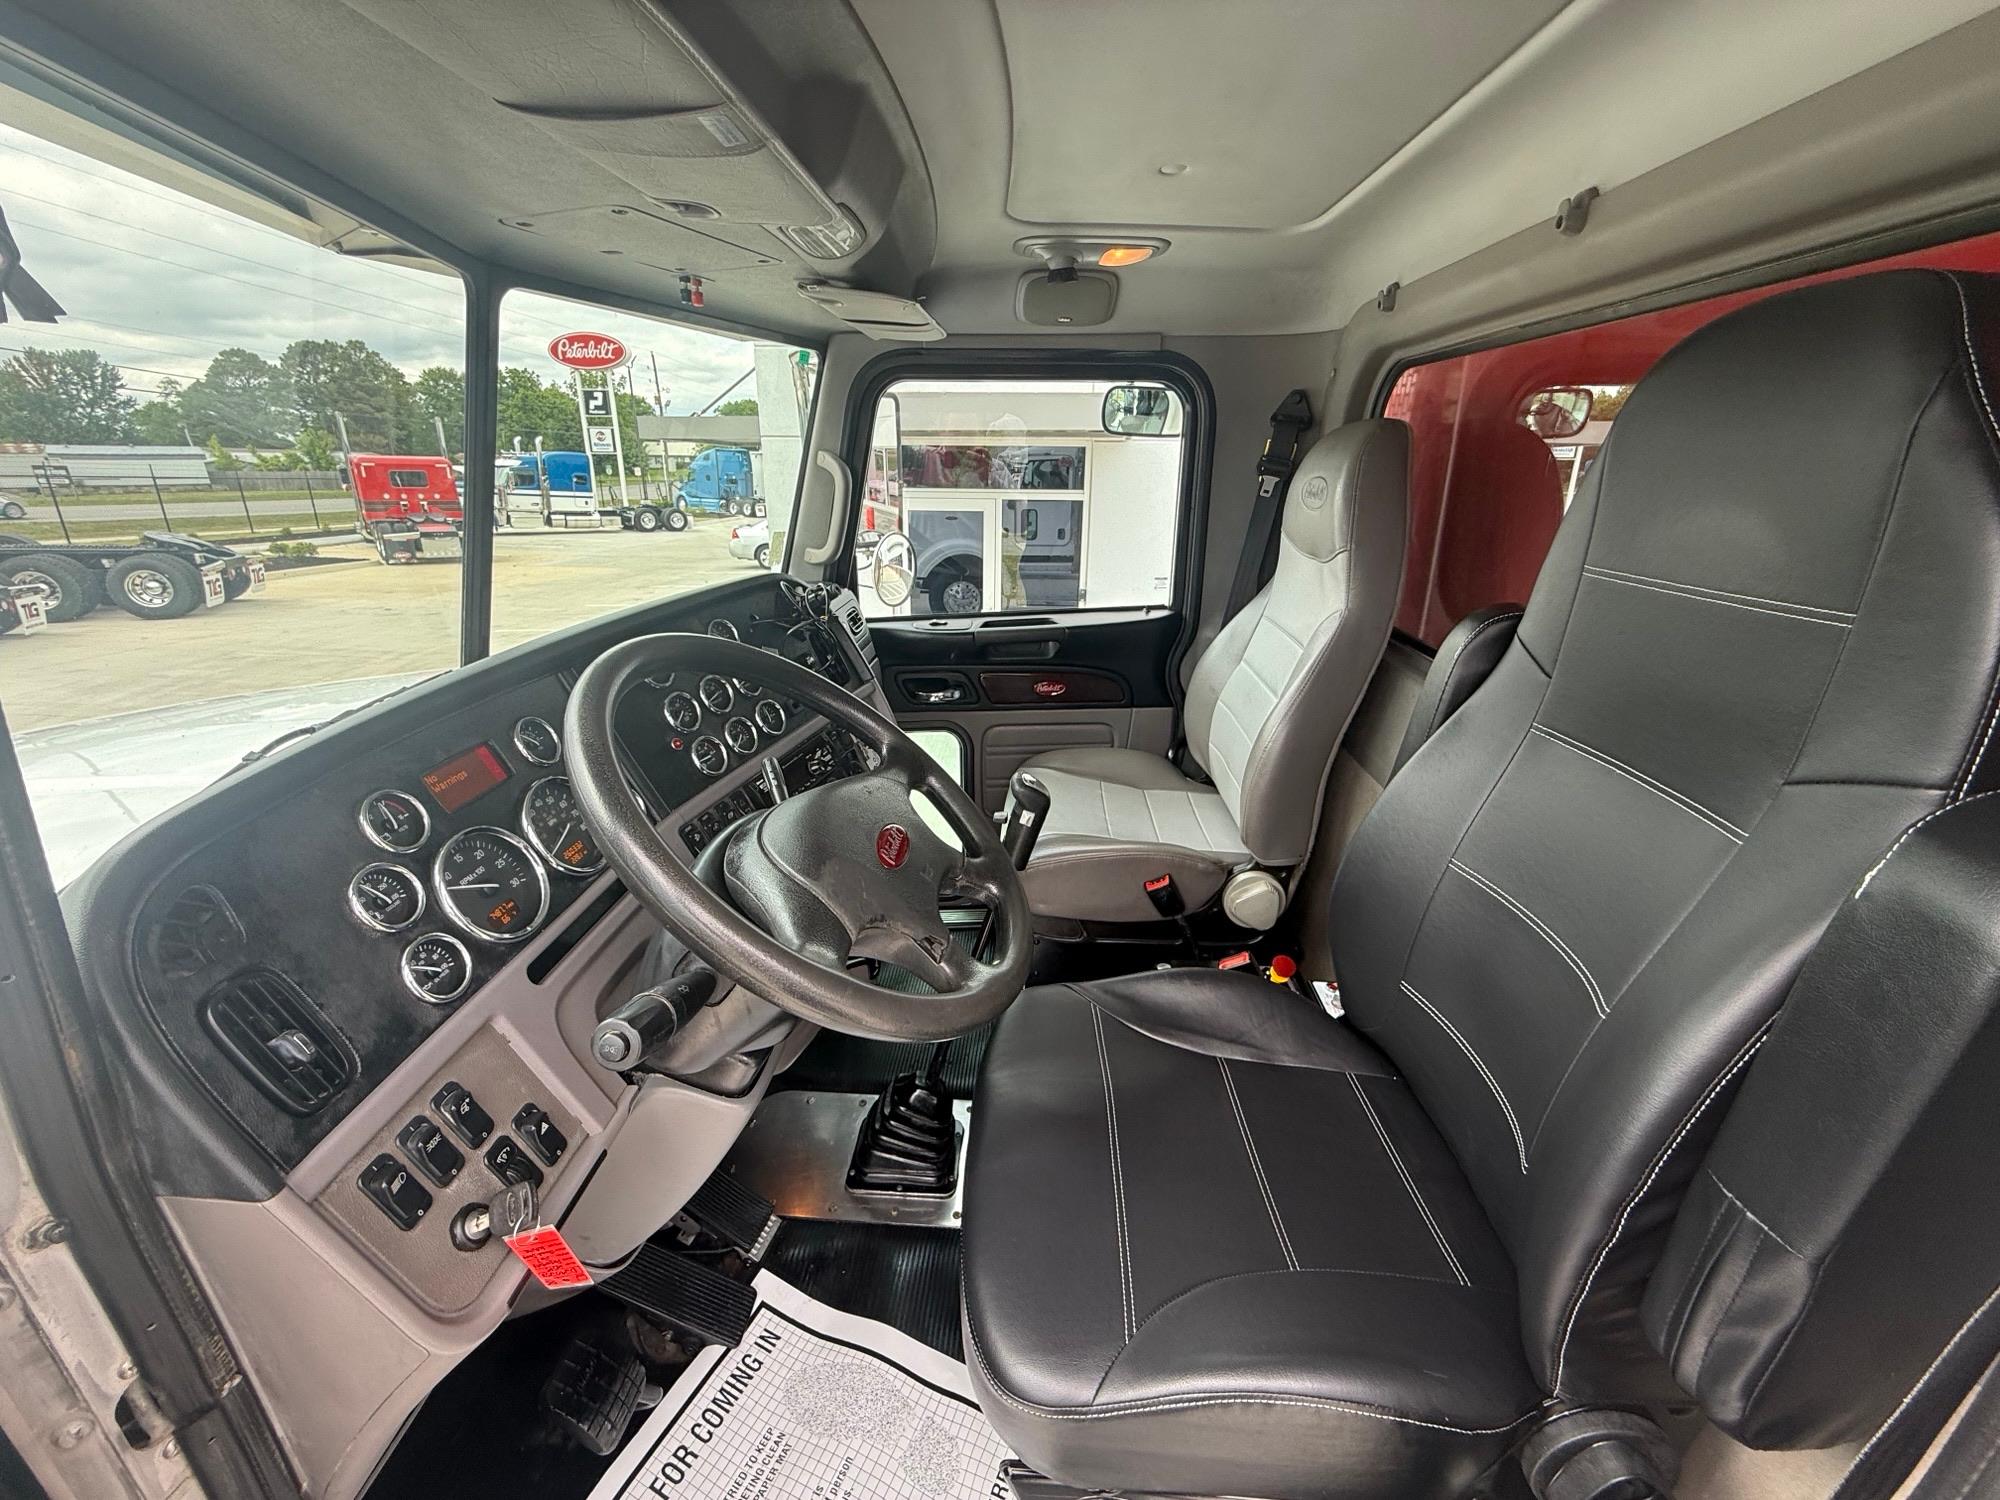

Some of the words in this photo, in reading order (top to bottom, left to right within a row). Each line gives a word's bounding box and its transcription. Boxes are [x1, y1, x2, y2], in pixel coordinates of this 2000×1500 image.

[557, 338, 619, 360] Peterbilt
[423, 775, 438, 785] No
[430, 770, 468, 793] Warnings
[453, 853, 464, 864] 15
[473, 849, 485, 860] 20
[494, 858, 506, 869] 25
[509, 877, 520, 888] 30
[648, 1444, 699, 1500] FOR
[690, 1353, 764, 1444] COMING
[753, 1328, 782, 1354] IN
[743, 1455, 758, 1470] TO
[755, 1427, 773, 1454] KEEP
[762, 1432, 786, 1466] CLEAN
[776, 1442, 793, 1465] MAT
[830, 1456, 854, 1496] person
[812, 1485, 824, 1496] is
